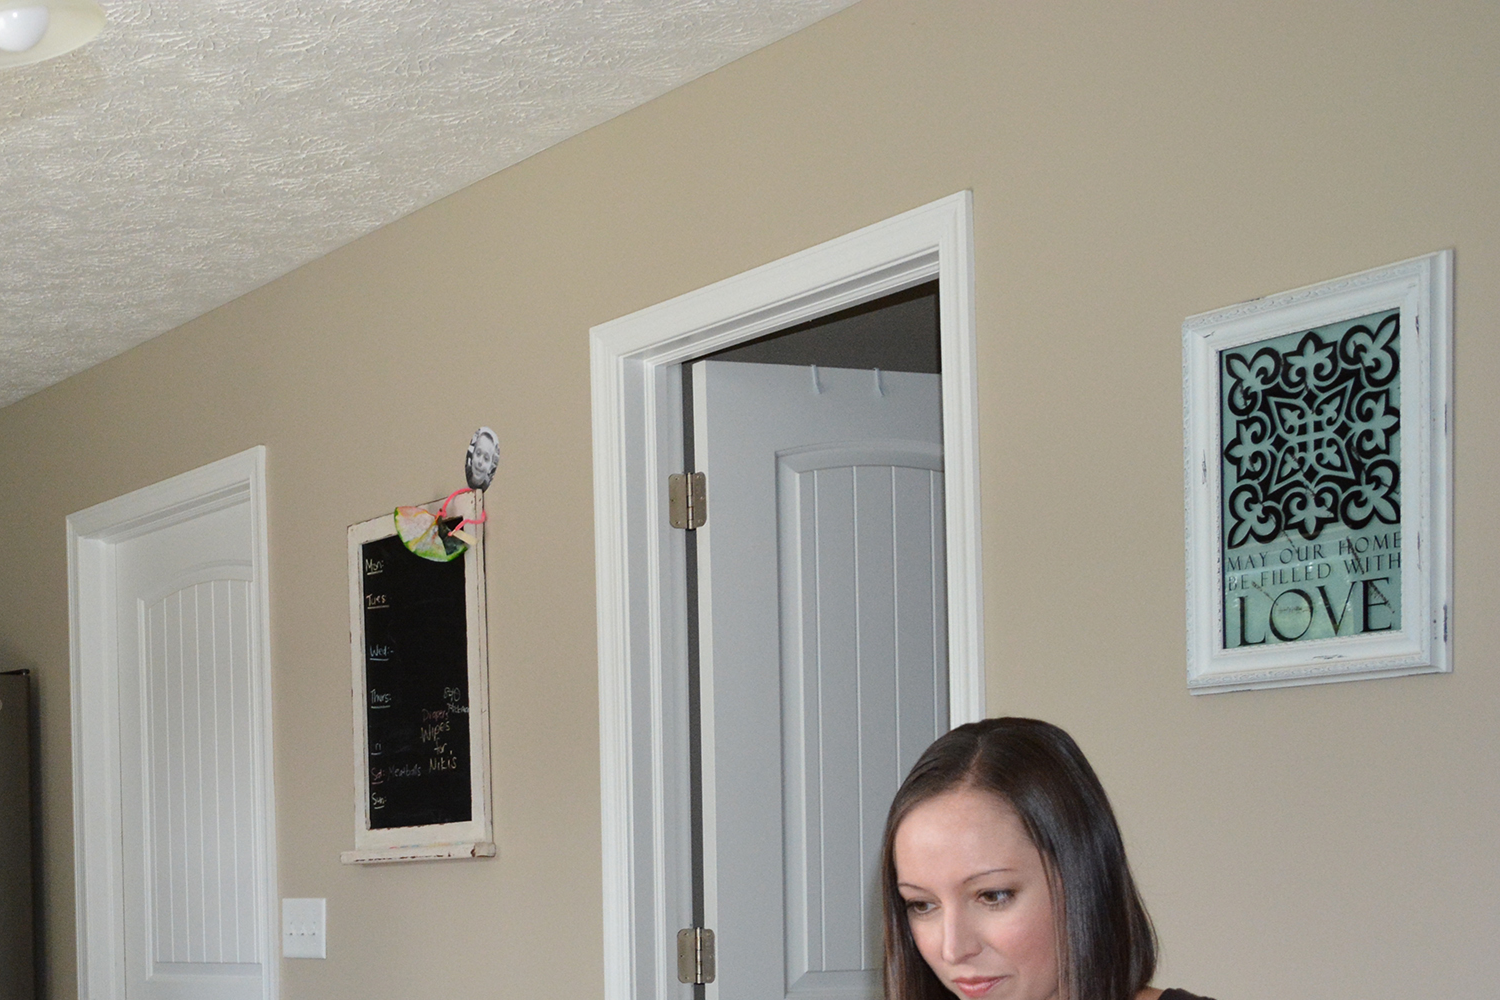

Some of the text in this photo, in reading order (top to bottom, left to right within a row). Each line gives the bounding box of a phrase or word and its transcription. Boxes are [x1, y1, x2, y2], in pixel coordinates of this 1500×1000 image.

[1226, 532, 1402, 572] MAY OUR HOME
[1227, 552, 1401, 592] BE FILLED WITH
[1237, 576, 1393, 647] LOVE
